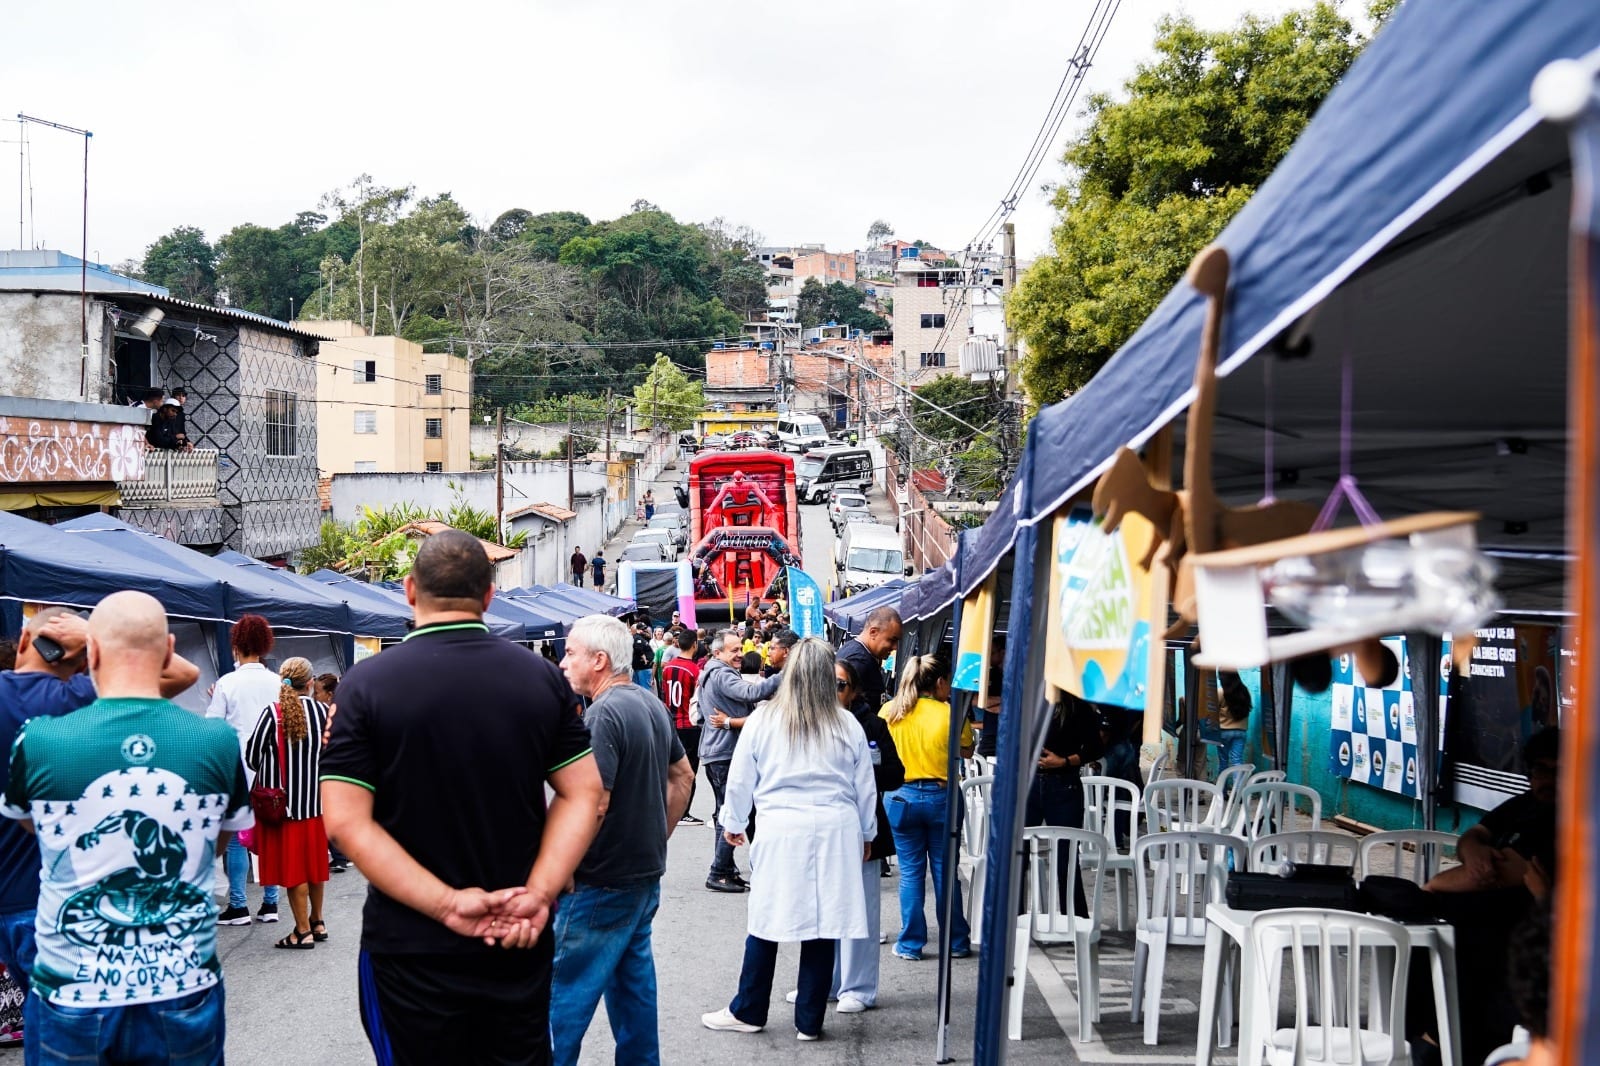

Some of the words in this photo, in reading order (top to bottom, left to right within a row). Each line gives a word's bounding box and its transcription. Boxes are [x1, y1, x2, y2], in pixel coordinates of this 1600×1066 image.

[714, 532, 772, 550] AVENGERS
[667, 680, 682, 707] 10
[97, 947, 126, 965] NA
[132, 940, 182, 965] ALMA
[76, 963, 90, 978] E
[94, 968, 121, 986] NO
